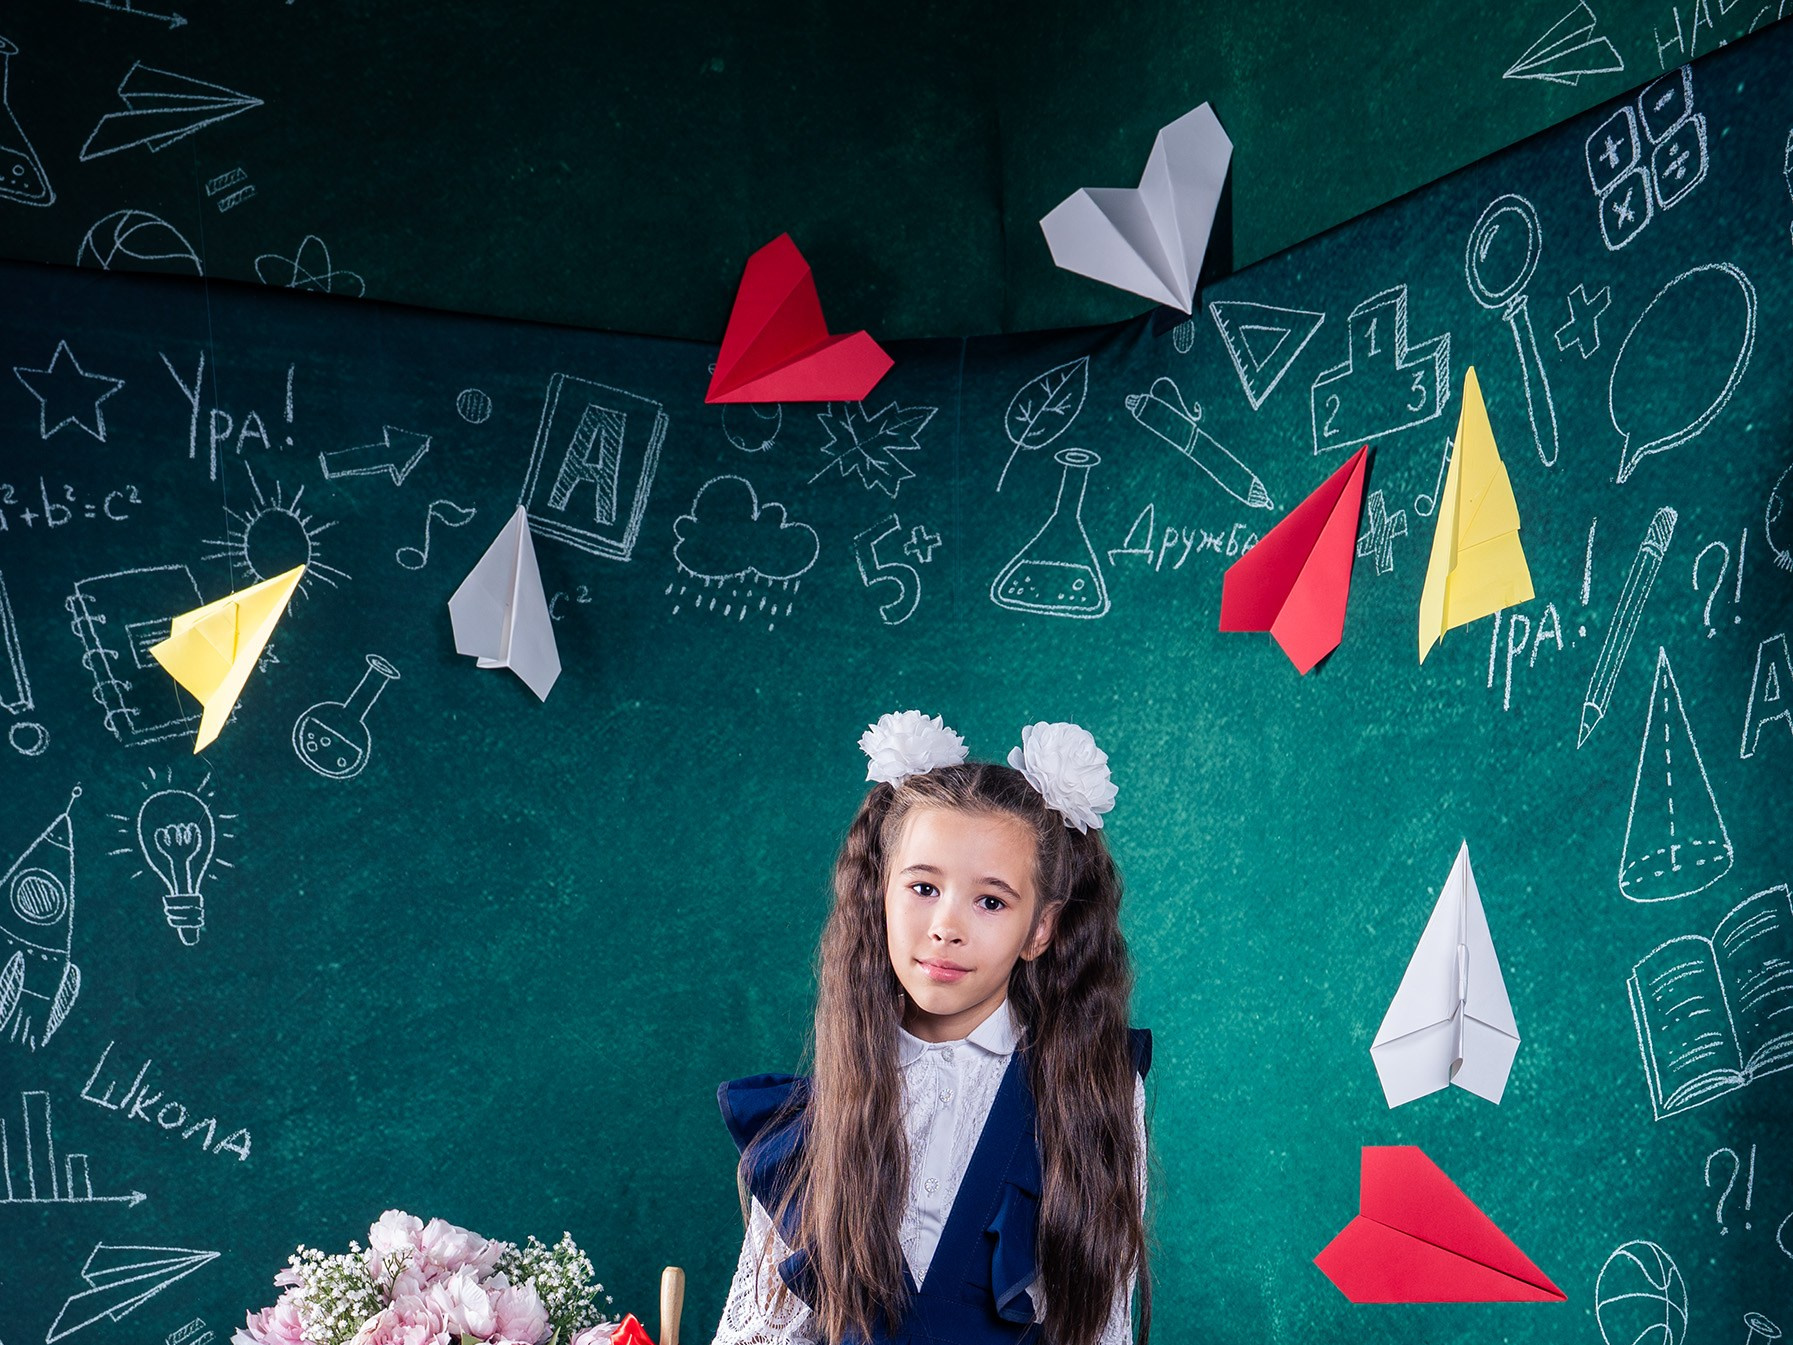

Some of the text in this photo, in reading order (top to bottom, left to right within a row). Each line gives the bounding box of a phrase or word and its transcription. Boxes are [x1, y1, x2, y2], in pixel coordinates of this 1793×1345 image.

[1653, 0, 1739, 70] НА
[1364, 317, 1382, 358] 1
[1407, 370, 1427, 412] 3
[1323, 394, 1340, 438] 2
